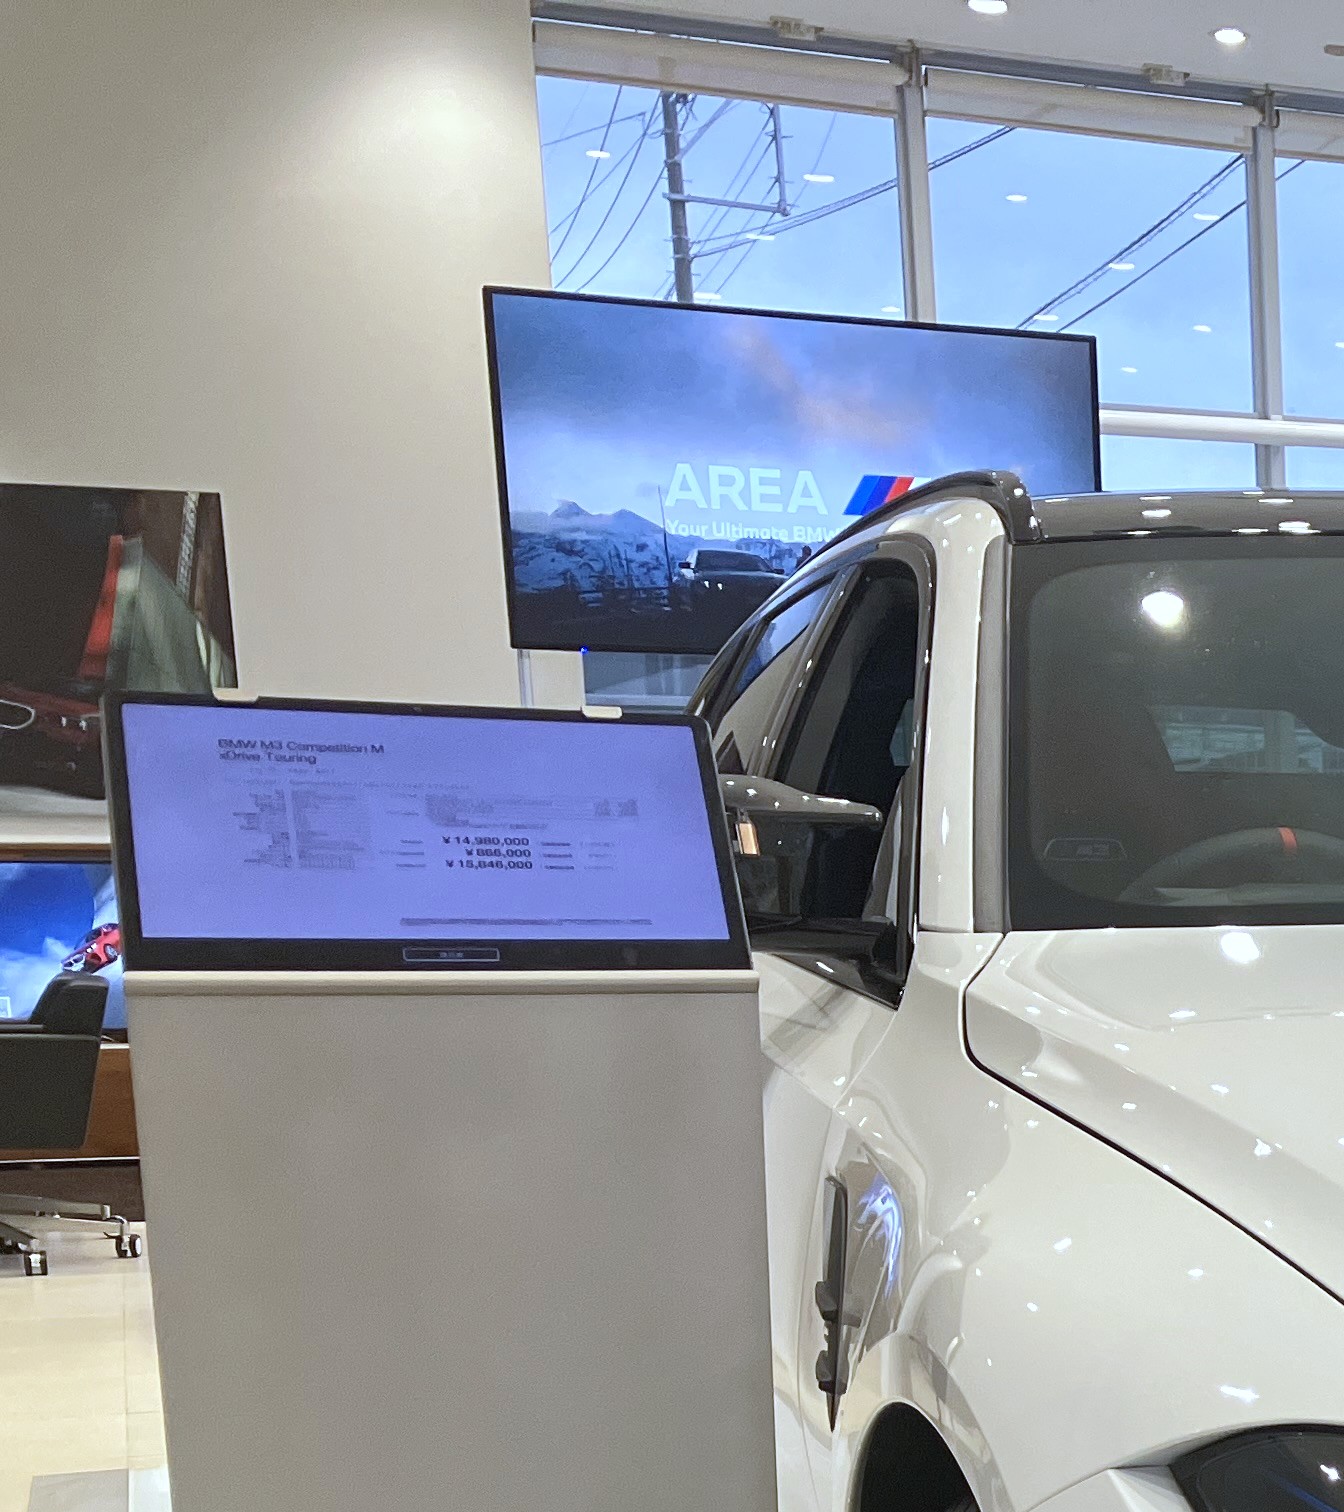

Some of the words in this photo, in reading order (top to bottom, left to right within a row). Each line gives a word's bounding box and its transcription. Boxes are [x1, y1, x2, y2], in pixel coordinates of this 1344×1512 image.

[664, 462, 828, 515] AREA
[666, 518, 709, 538] Your
[712, 520, 789, 541] Ultimate
[792, 525, 840, 543] BMW
[217, 738, 257, 750] BMW
[260, 739, 283, 751] M3
[286, 741, 368, 755] Competition
[371, 744, 385, 754] M
[267, 752, 317, 765] Touring
